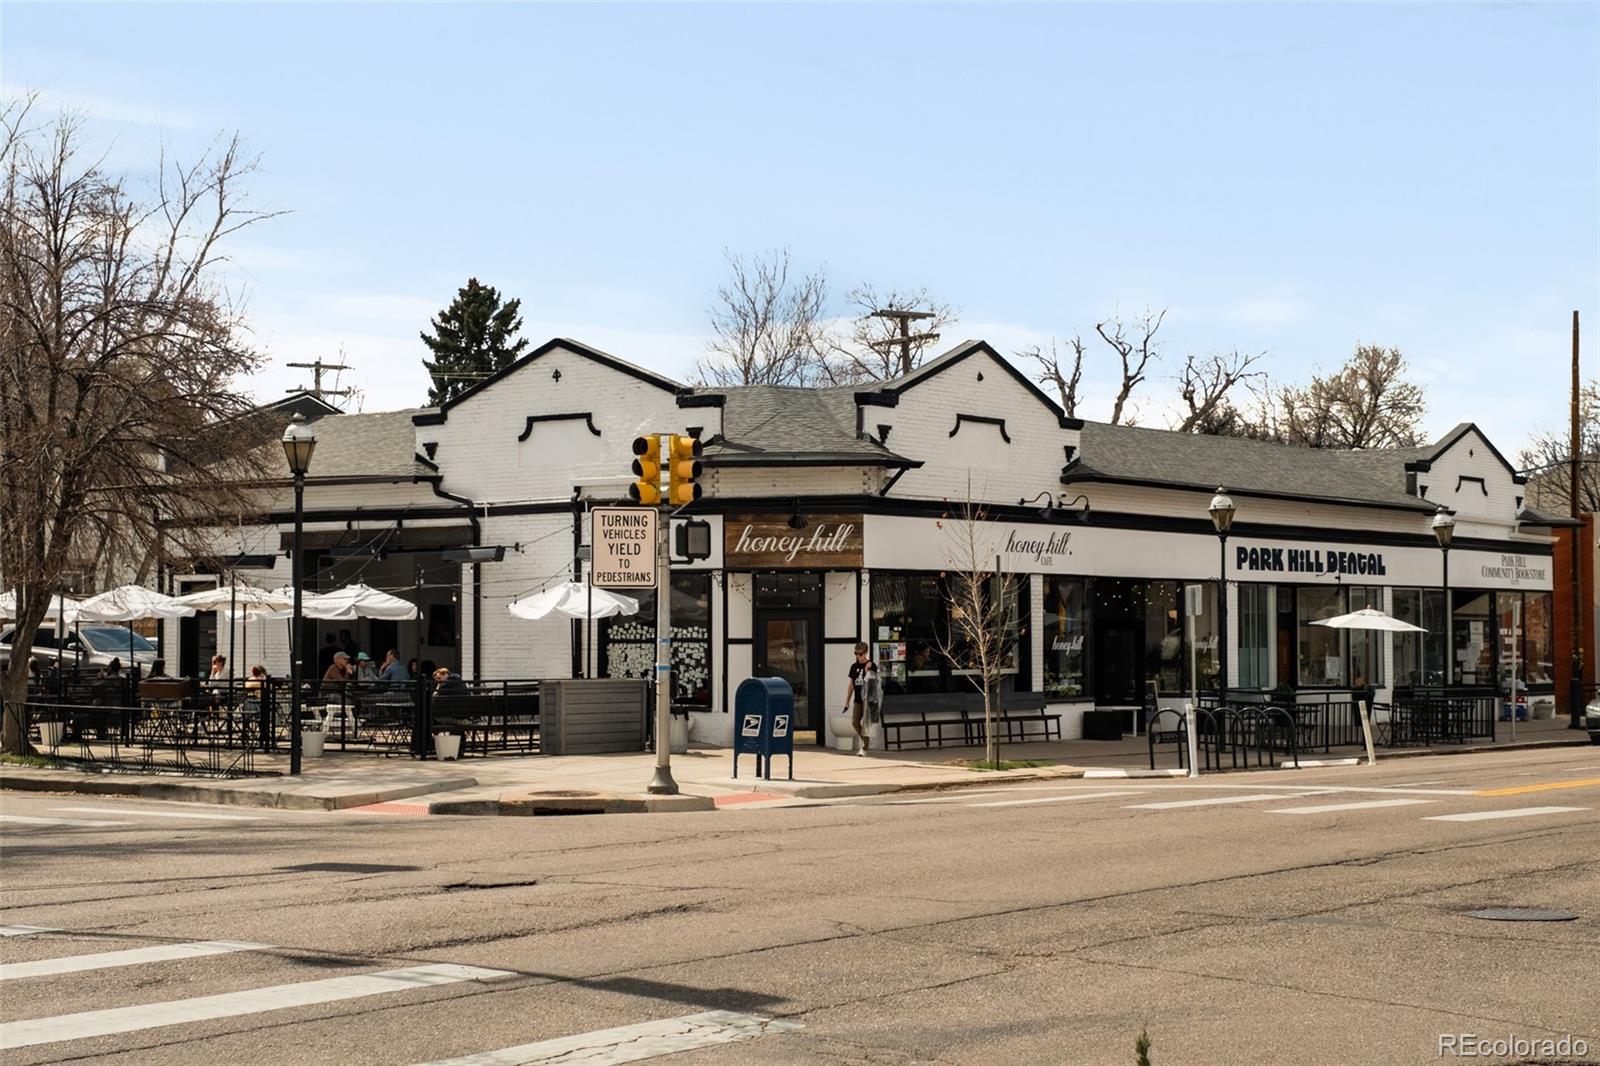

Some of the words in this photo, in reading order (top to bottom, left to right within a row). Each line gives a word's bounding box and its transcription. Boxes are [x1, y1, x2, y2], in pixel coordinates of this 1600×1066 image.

[601, 515, 648, 527] TURNING
[603, 529, 646, 540] VEHICLES
[735, 524, 804, 562] honey
[805, 523, 854, 552] hill
[1005, 529, 1045, 562] honey
[608, 543, 641, 556] YIELD
[618, 558, 630, 569] TO
[1236, 546, 1284, 571] PARK
[596, 572, 651, 583] PEDESTRIANS
